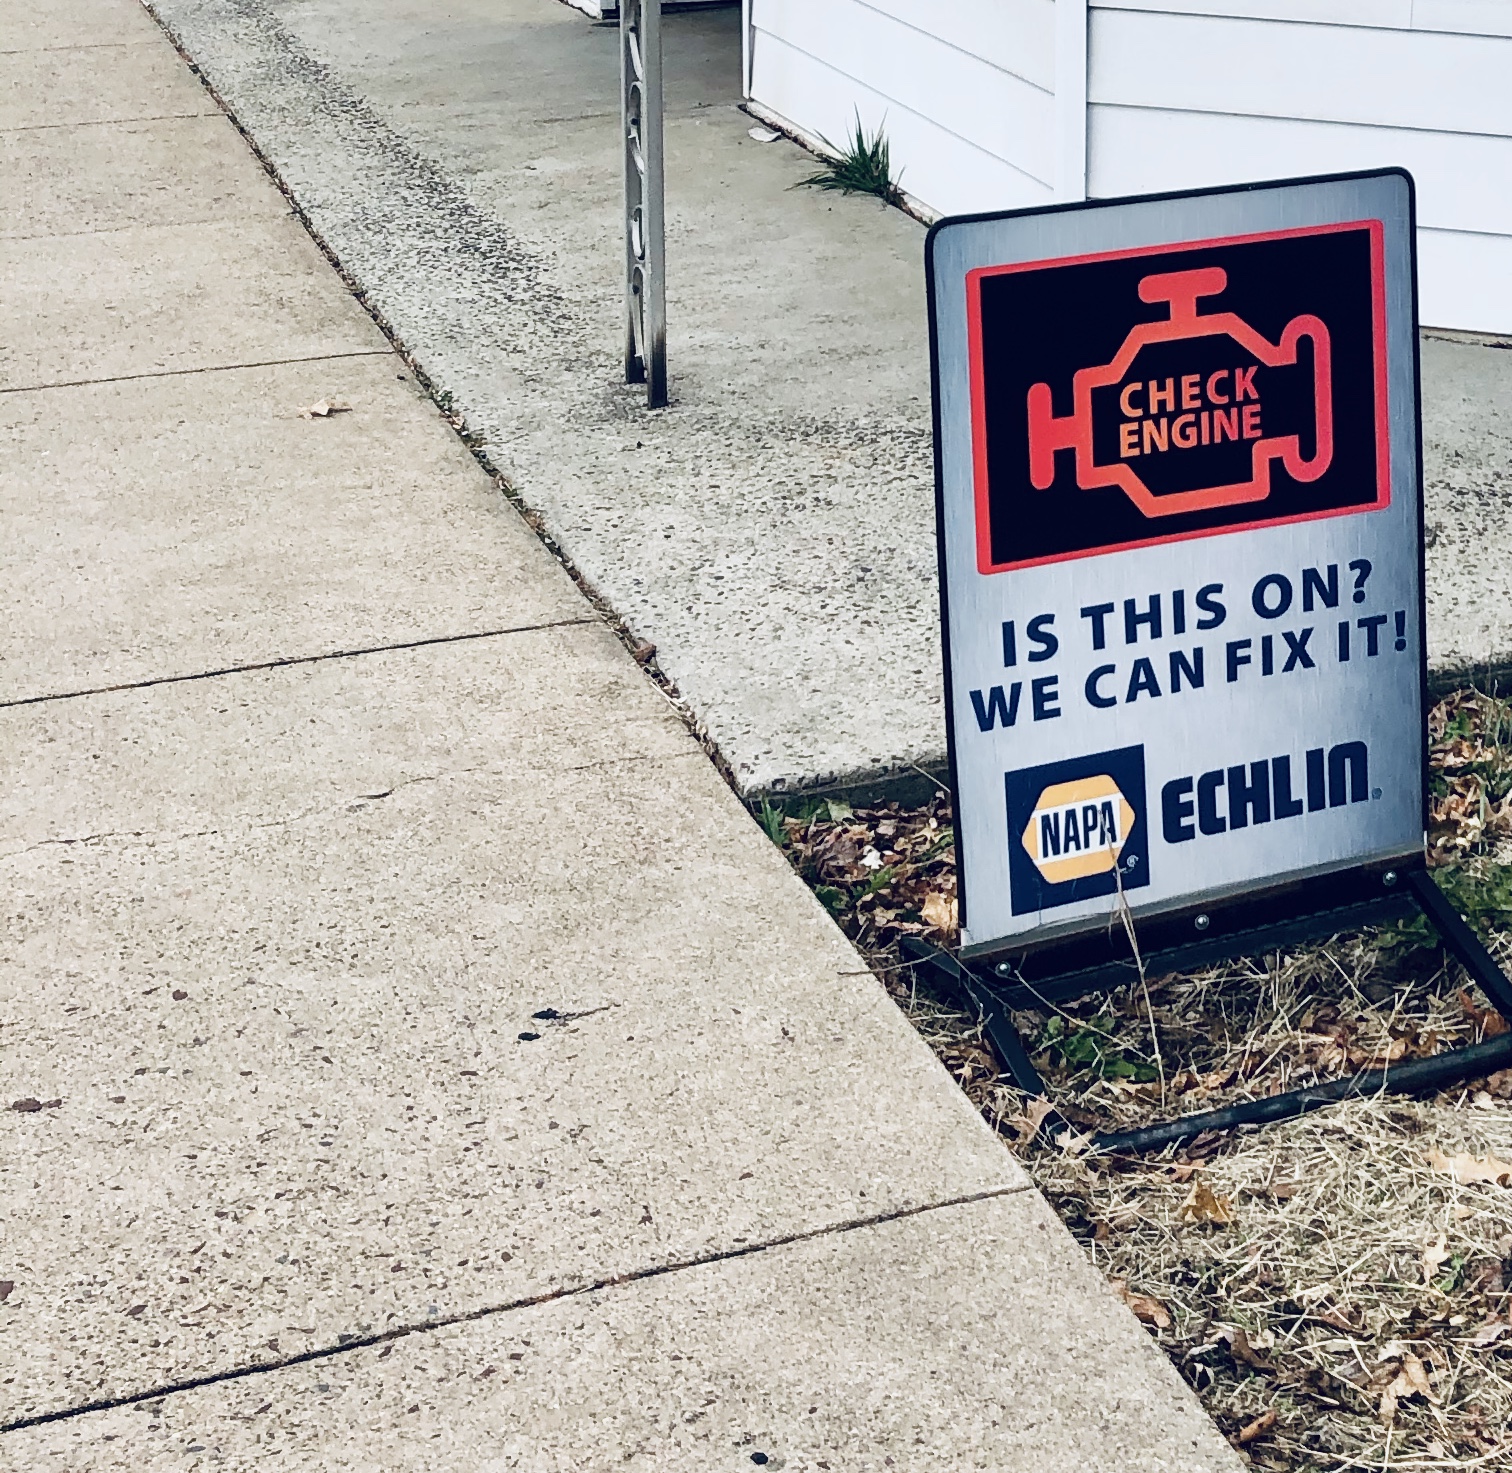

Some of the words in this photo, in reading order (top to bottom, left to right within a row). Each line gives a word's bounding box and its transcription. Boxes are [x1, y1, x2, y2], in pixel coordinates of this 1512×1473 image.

[1118, 365, 1260, 420] CHECK
[1118, 401, 1263, 460] ENGINE
[1001, 611, 1059, 669] IS
[1080, 582, 1227, 651] THIS
[1251, 557, 1373, 621] ON?
[968, 674, 1061, 734] WE
[1084, 646, 1204, 711] CAN
[1226, 626, 1315, 684] FIX
[1337, 609, 1407, 664] IT!
[1039, 800, 1118, 860] NAPA
[1160, 740, 1370, 844] ECHLIN
